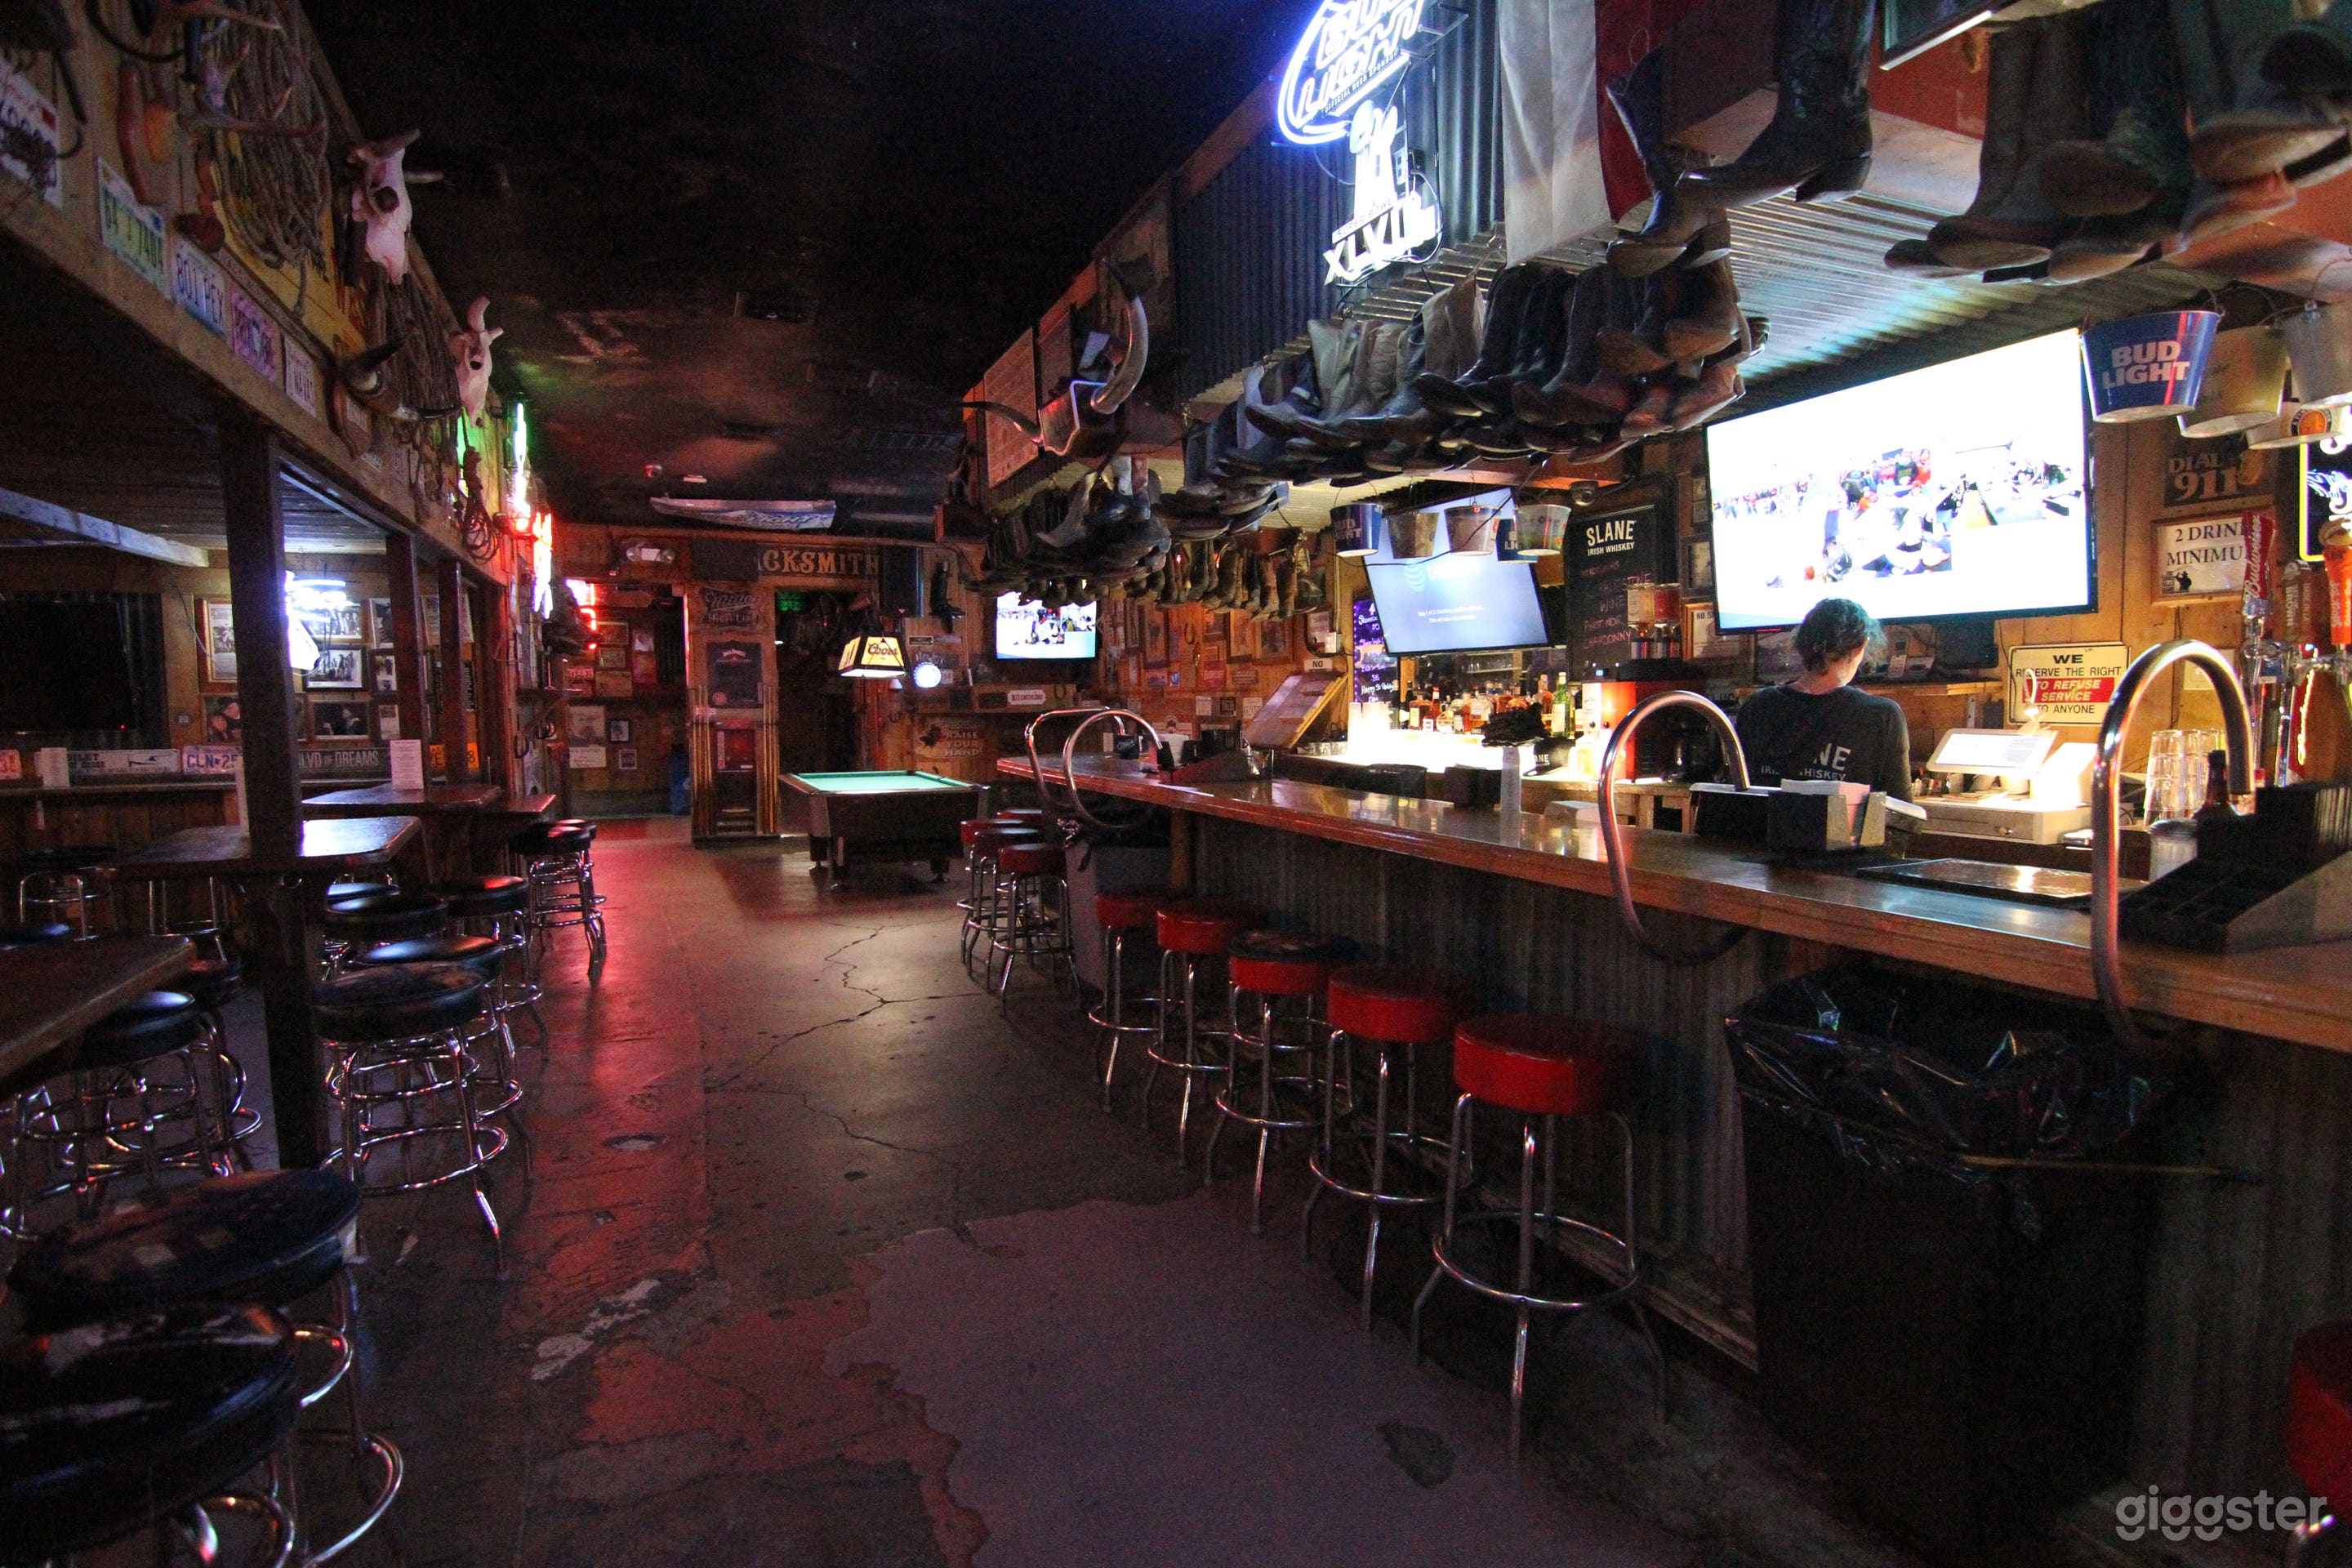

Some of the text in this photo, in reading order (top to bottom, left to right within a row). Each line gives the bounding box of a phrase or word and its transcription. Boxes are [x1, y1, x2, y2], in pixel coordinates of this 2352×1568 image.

[1324, 87, 1352, 114] OFFICIAL
[1352, 74, 1369, 91] BEER
[2111, 340, 2181, 368] BUD
[2102, 361, 2191, 390] LIGHT
[2168, 451, 2222, 474] DIAL
[2174, 466, 2238, 501] 911
[1586, 519, 1635, 546] SLANE
[2176, 528, 2183, 542] 2
[1588, 541, 1635, 556] IRISH WHISKEY
[2167, 546, 2247, 566] MINIMU
[2244, 514, 2263, 599] Budweiser
[2286, 586, 2294, 626] BROWN
[1312, 660, 1323, 668] NO
[2053, 654, 2083, 664] WE
[2016, 666, 2122, 677] RERVE THE RIGHT
[2053, 679, 2101, 689] REFUSE
[2041, 692, 2092, 701] SERVICE
[2053, 705, 2095, 714] ANYONE
[947, 731, 978, 739] RAISE
[298, 751, 322, 769] LVD
[334, 750, 379, 768] DREAMS
